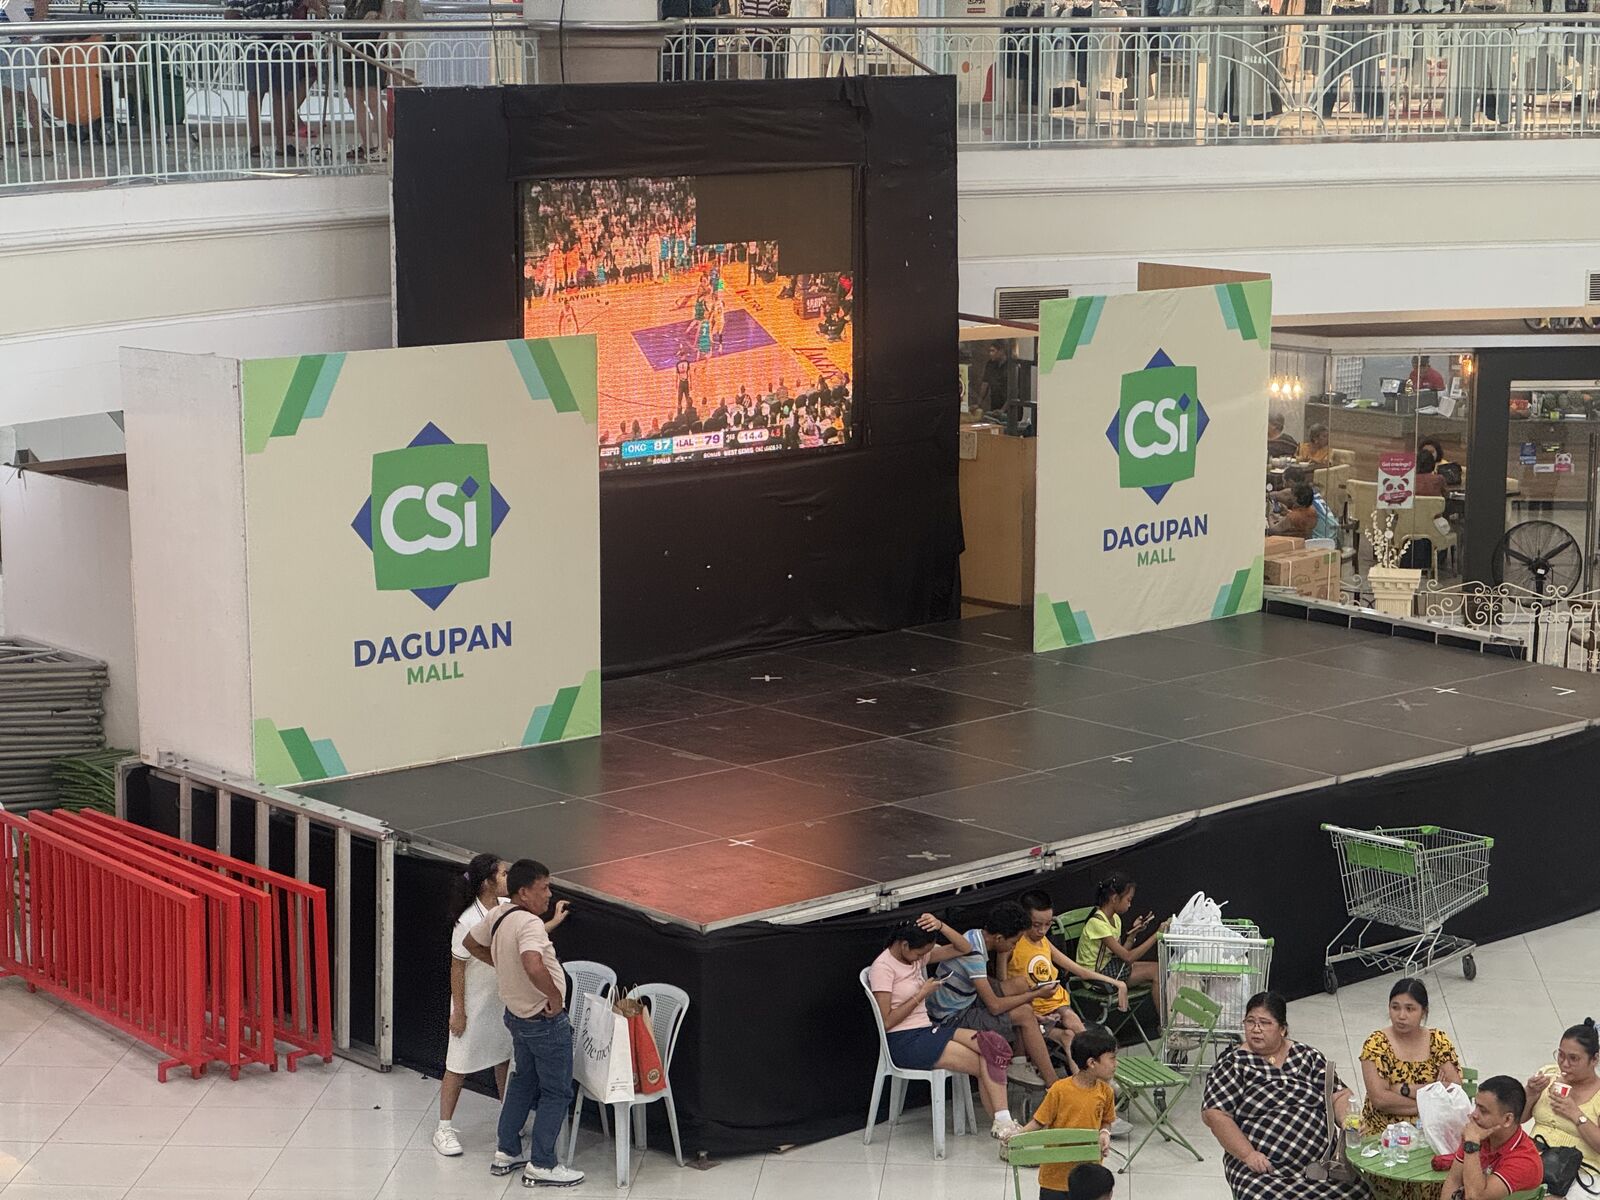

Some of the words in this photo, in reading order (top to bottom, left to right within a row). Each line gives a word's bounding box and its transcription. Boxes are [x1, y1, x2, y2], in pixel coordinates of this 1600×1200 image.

[679, 439, 694, 448] LAL
[704, 434, 720, 445] 79
[1124, 392, 1191, 459] CSi
[628, 443, 647, 452] OKC
[653, 439, 671, 451] 87
[379, 475, 480, 556] CSi
[1103, 514, 1208, 552] DAGUPAN
[1137, 547, 1176, 567] MALL
[353, 620, 513, 668] DAGUPAN
[406, 661, 465, 686] MALL
